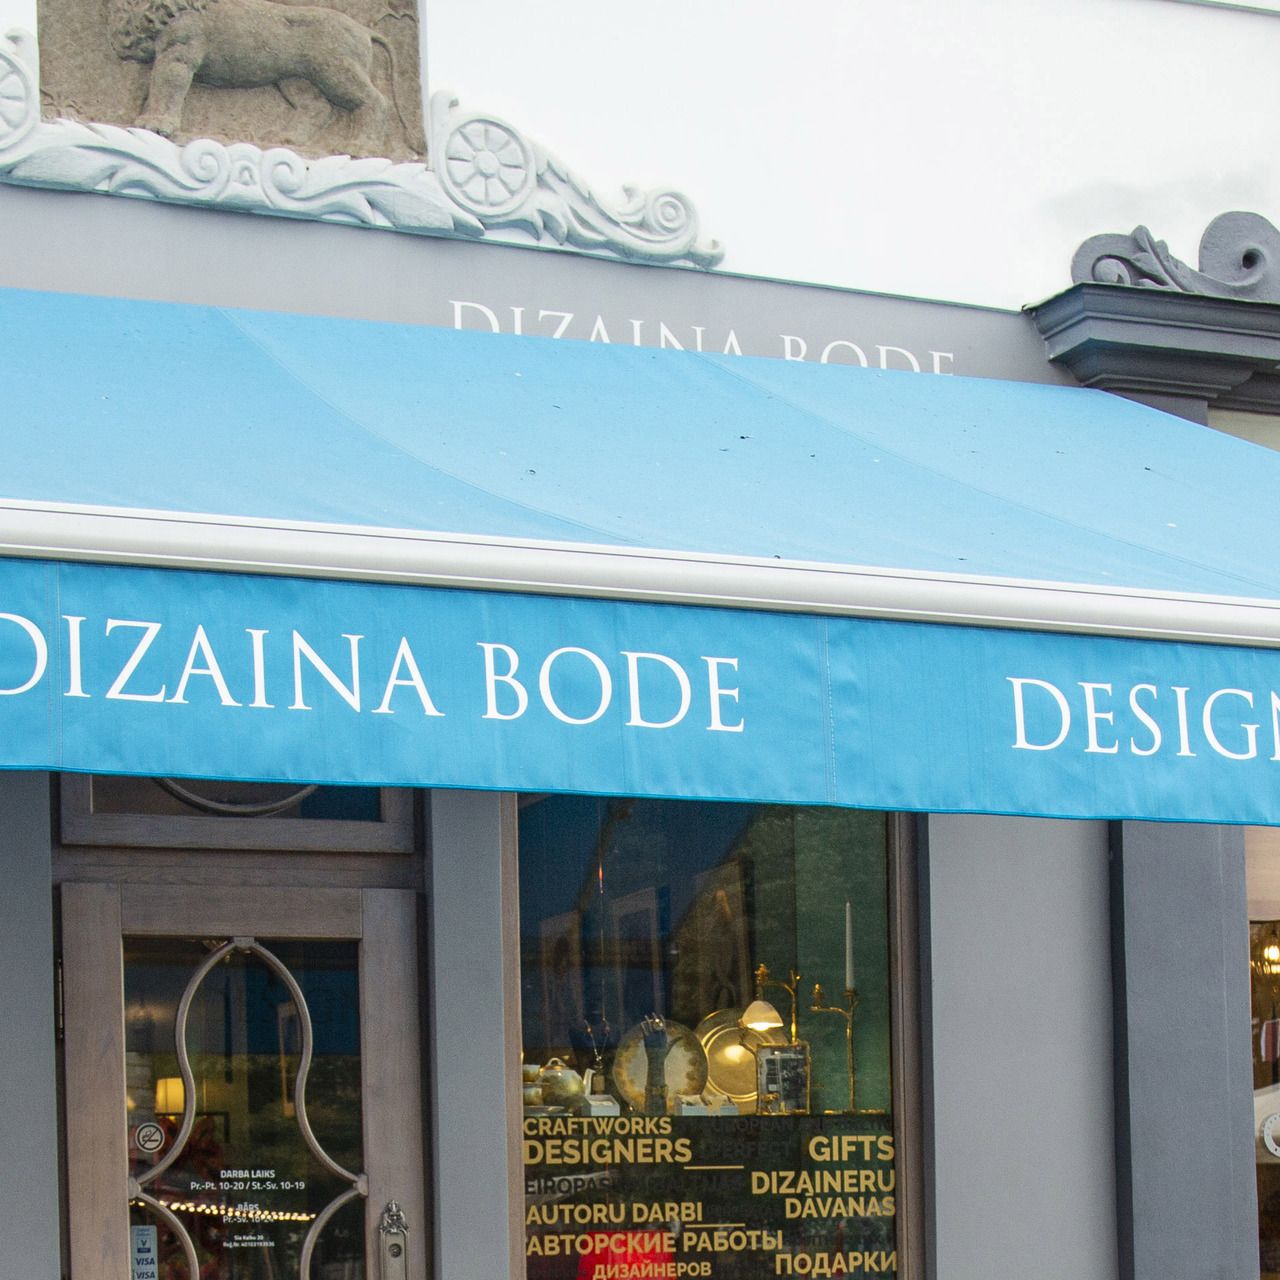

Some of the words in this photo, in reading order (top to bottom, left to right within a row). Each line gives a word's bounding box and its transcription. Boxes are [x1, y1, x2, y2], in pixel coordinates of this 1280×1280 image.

[477, 642, 745, 733] BODE
[524, 1117, 672, 1136] CRAFTWORKS
[524, 1138, 693, 1165] DESIGNERS
[808, 1135, 895, 1162] GIFTS
[219, 1181, 245, 1190] 10-20
[280, 1181, 306, 1190] 10-19
[220, 1169, 250, 1179] DARBA
[251, 1169, 276, 1179] LAIKS
[751, 1169, 896, 1195] DIZAINERU
[526, 1203, 626, 1225] AUTORU
[632, 1202, 703, 1223] DARBI
[526, 1231, 677, 1257] АВТОРСКИЕ
[683, 1229, 783, 1253] РАБОТЫ
[135, 1257, 156, 1266] VISA
[775, 1250, 897, 1279] ПОДАРКИ
[135, 1271, 156, 1280] VISA
